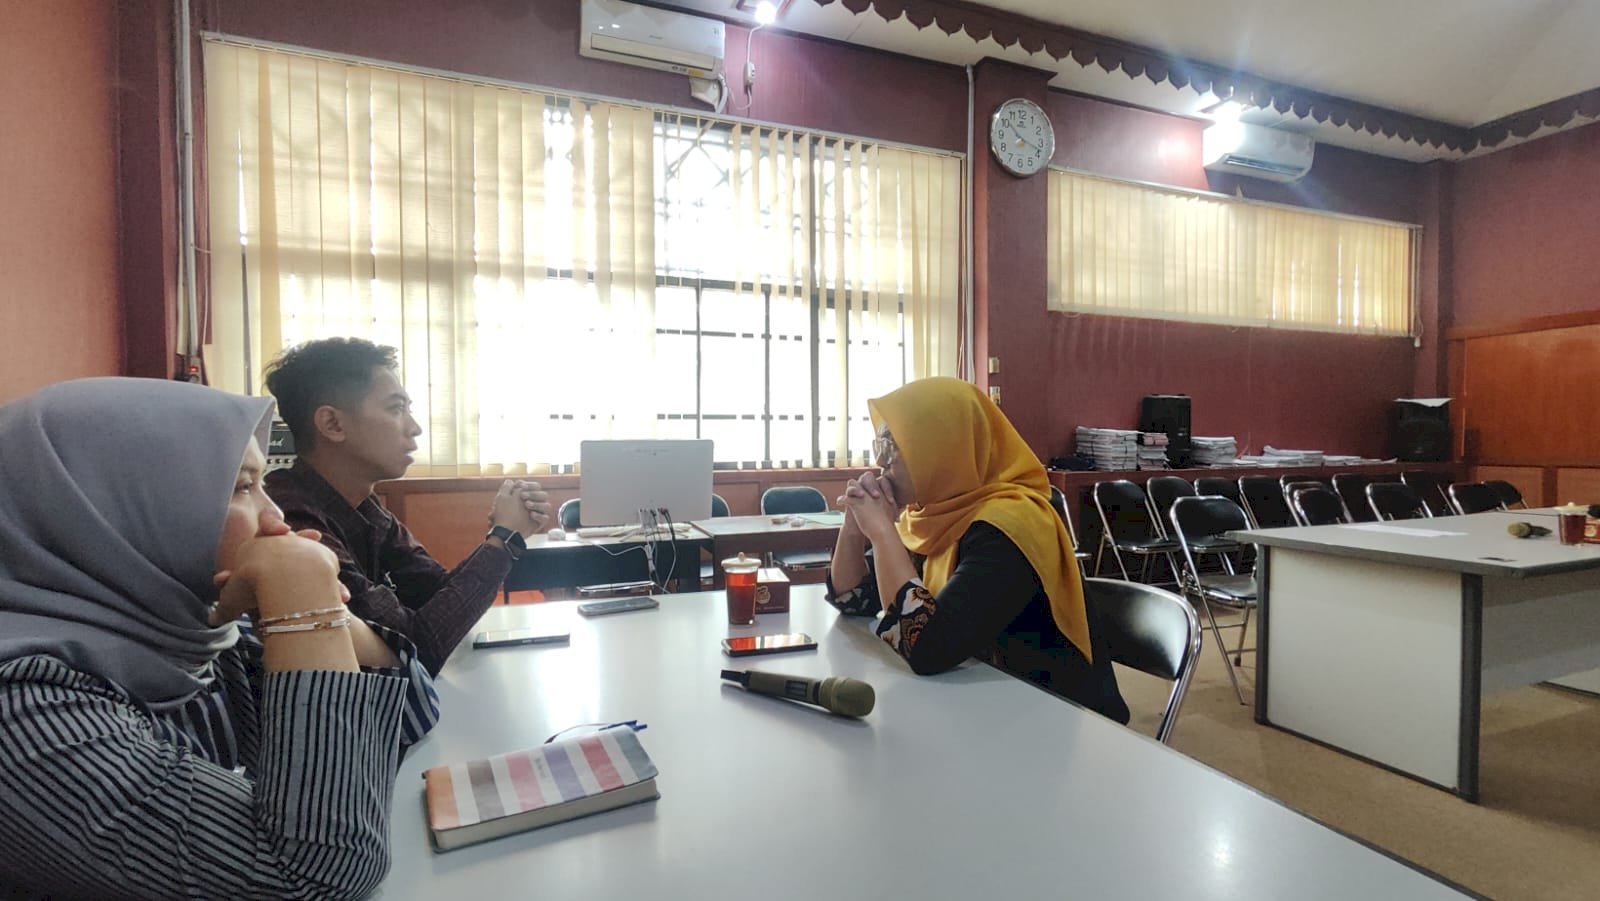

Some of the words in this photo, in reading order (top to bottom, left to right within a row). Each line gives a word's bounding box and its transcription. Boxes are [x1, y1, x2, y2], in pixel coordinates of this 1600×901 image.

[1009, 111, 1015, 120] 11
[1018, 110, 1027, 120] 12
[1030, 115, 1034, 125] 1
[1001, 118, 1009, 128] 10
[998, 129, 1004, 139] 9
[1036, 126, 1042, 135] 2
[1000, 142, 1006, 152] 8
[1038, 138, 1043, 148] 3
[1008, 152, 1013, 162] 7
[1035, 149, 1042, 158] 4
[1017, 158, 1023, 168] 6
[1027, 157, 1033, 166] 5
